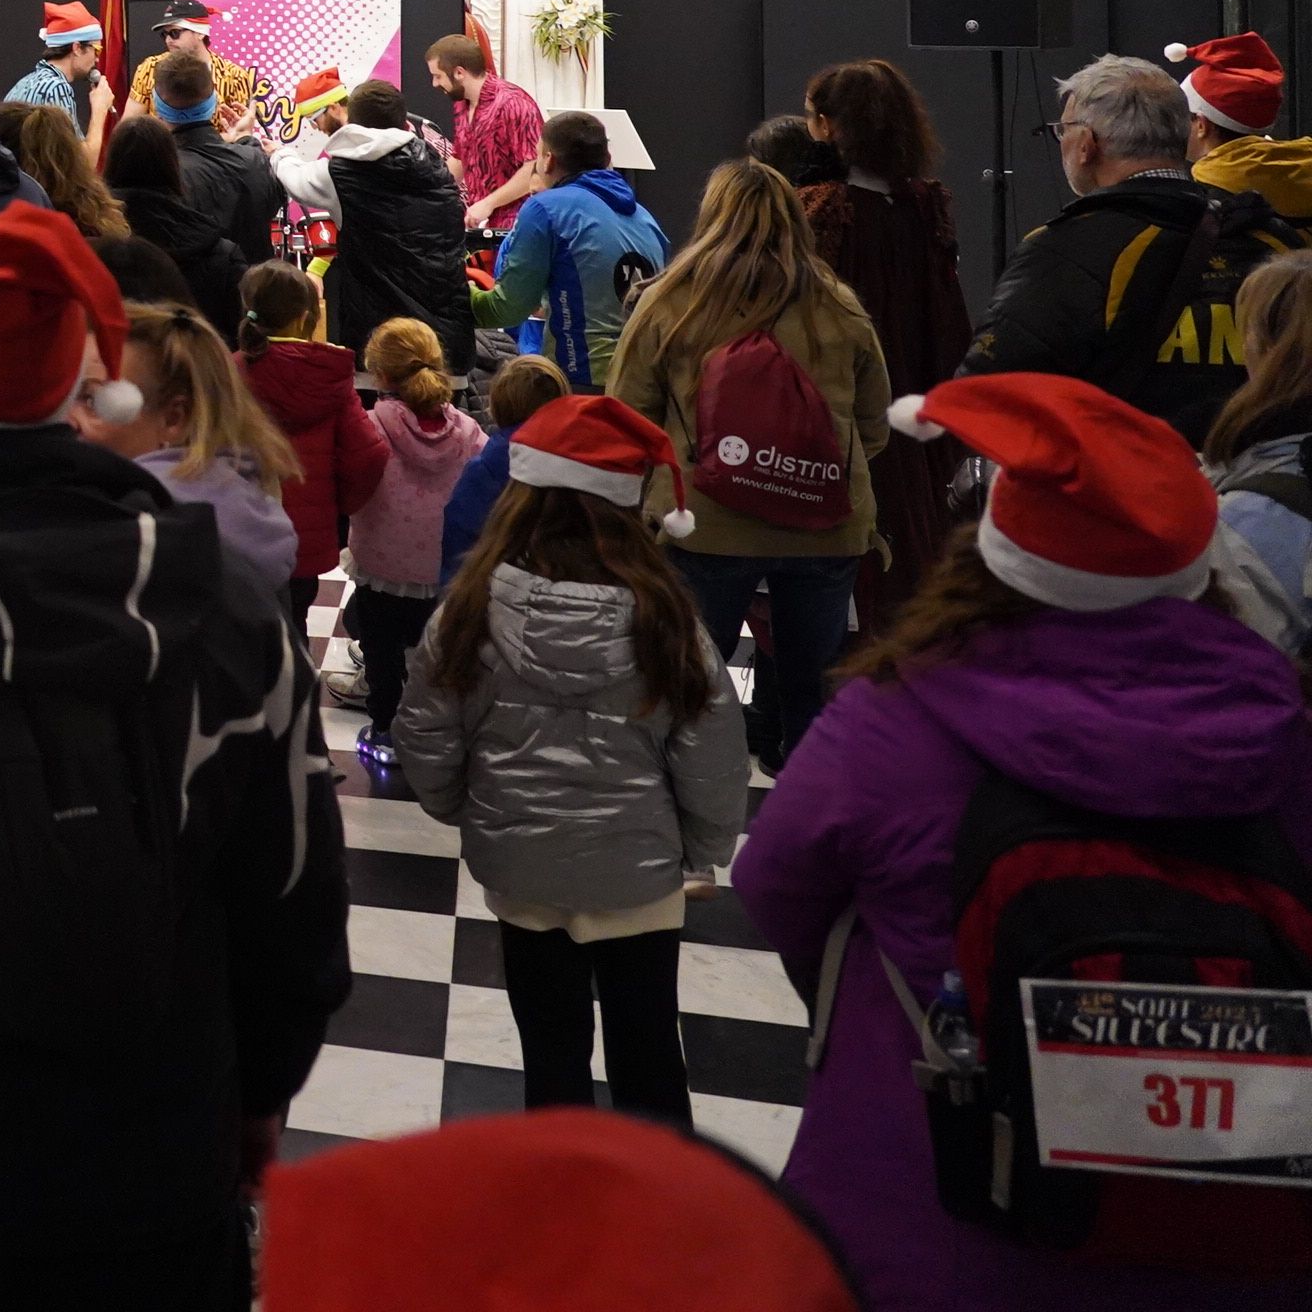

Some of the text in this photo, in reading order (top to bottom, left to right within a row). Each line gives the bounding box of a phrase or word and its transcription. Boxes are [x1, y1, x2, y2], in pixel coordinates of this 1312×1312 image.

[1156, 303, 1246, 366] AN
[732, 475, 823, 503] www.distria.com
[1143, 1073, 1236, 1132] 377
